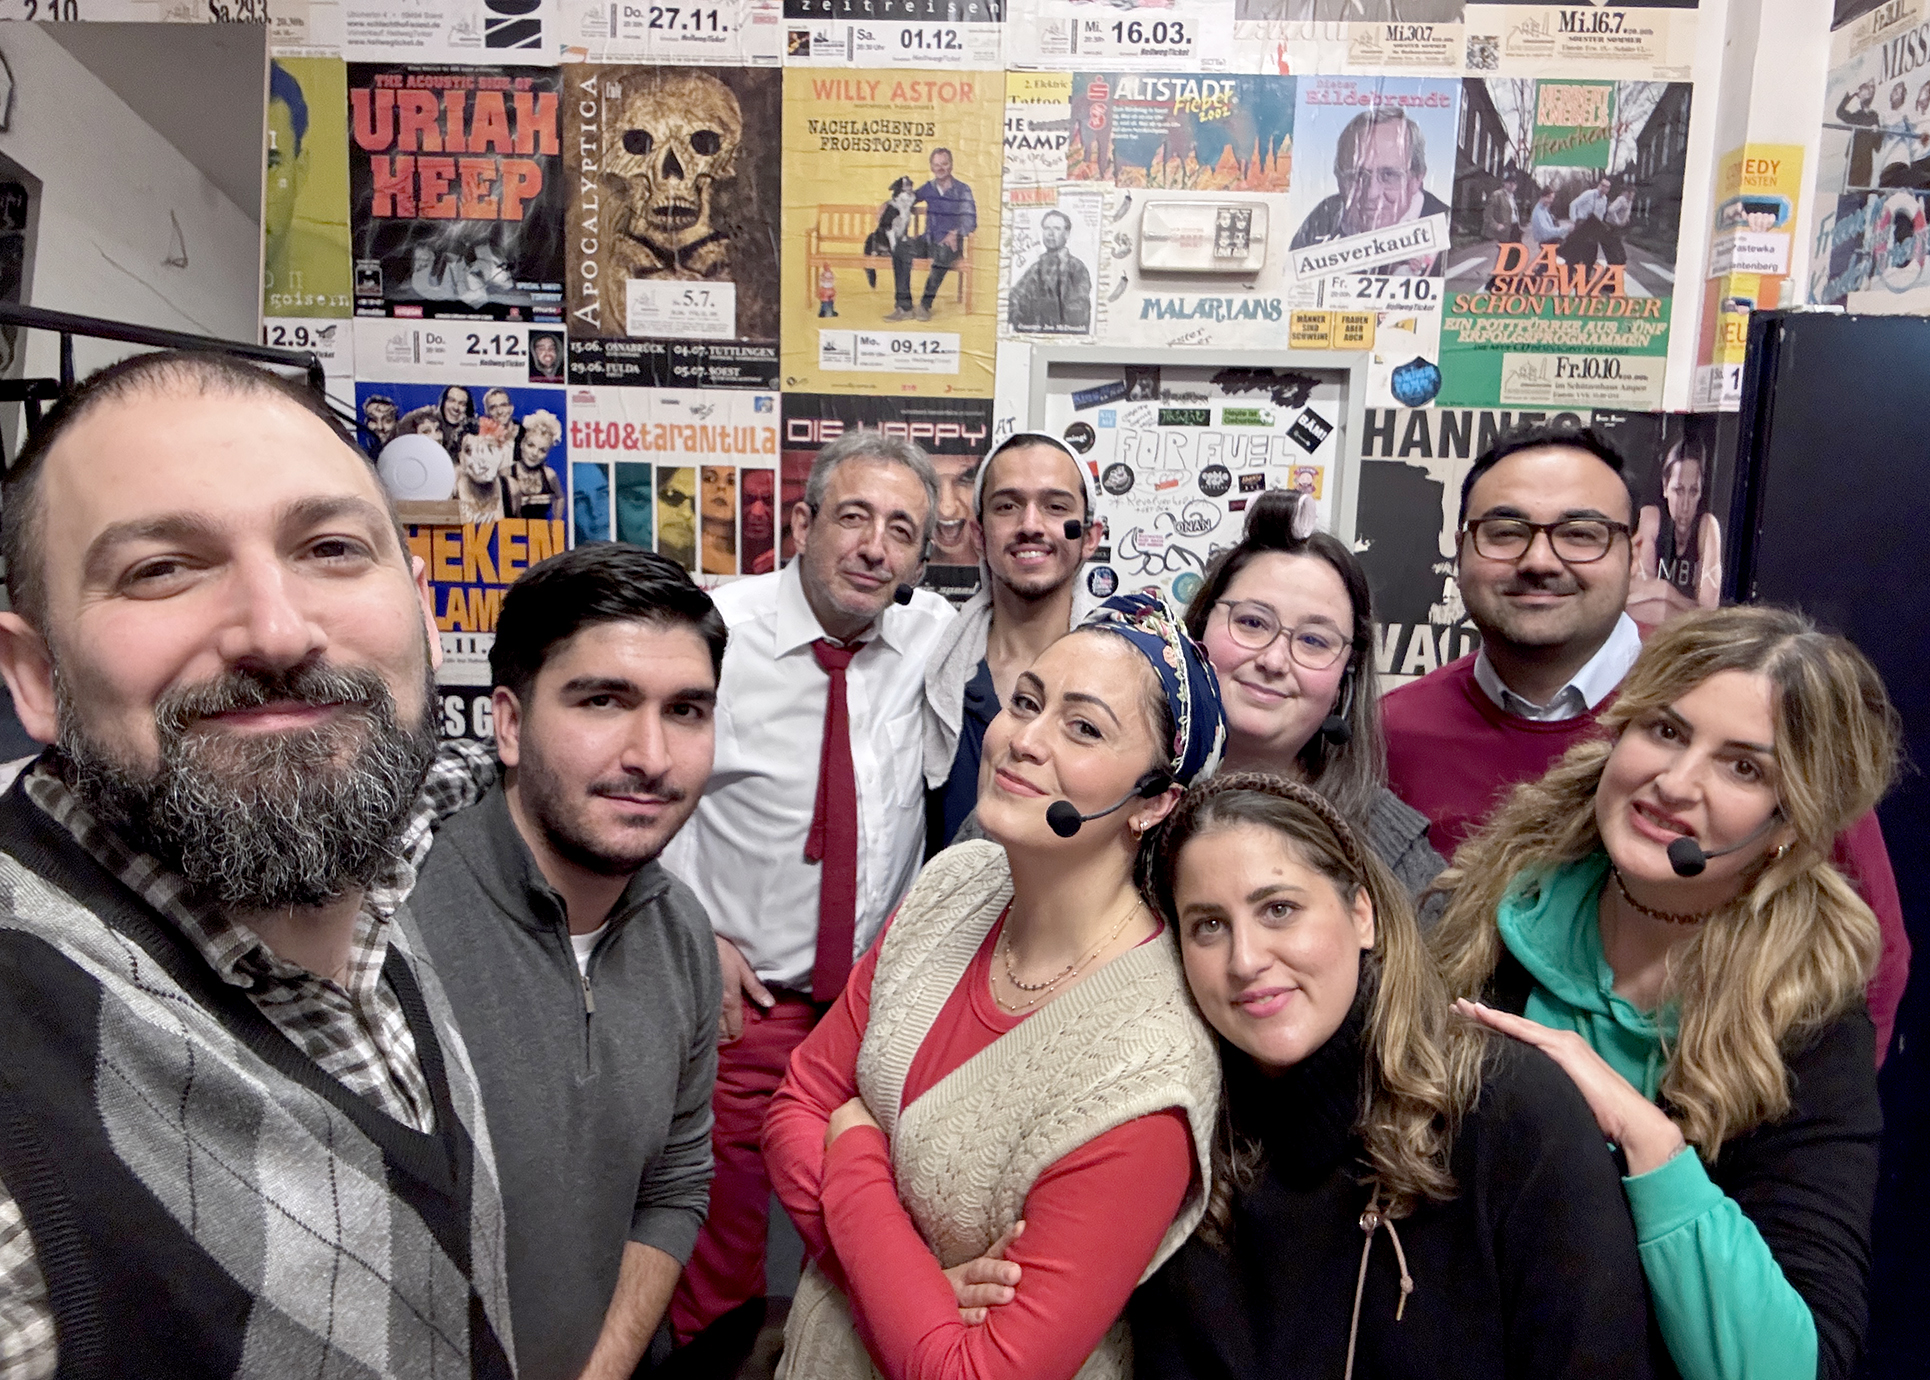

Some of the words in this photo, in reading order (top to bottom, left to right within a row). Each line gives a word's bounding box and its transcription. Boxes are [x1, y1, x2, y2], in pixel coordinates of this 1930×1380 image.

[624, 6, 644, 17] Do.
[648, 7, 727, 31] 27.11.
[857, 29, 875, 41] Sa.
[901, 28, 962, 50] 01.12.
[1085, 21, 1102, 32] Mi.
[1111, 20, 1191, 44] 16.03.
[1879, 22, 1930, 86] MISS
[375, 74, 403, 87] THE
[406, 75, 473, 88] ACOUSTIC
[813, 78, 882, 102] WILLY
[890, 81, 975, 103] ASTOR
[1113, 77, 1236, 104] ALTSTADT
[1305, 90, 1451, 108] Hildebrandt
[350, 88, 560, 155] URIAH
[1199, 106, 1231, 123] 2002
[808, 119, 936, 137] NACHLACHENDE
[820, 137, 923, 153] FROHSTOFFE
[371, 154, 543, 221] HEEP
[573, 75, 602, 330] APOCALYPTICA
[1299, 227, 1431, 275] Ausverkauft
[1491, 242, 1559, 277] DA
[1332, 277, 1348, 288] Fr.
[1356, 277, 1438, 302] 27.10.
[1491, 279, 1557, 295] SIND
[1556, 264, 1626, 298] WA
[683, 289, 716, 307] 5.7.
[1452, 294, 1545, 316] SCHON
[1553, 297, 1662, 319] WIEDER
[1138, 298, 1282, 324] MALARIANS
[1443, 317, 1473, 331] EIN
[1583, 320, 1618, 334] AUS
[427, 333, 446, 345] Do.
[467, 334, 527, 360] 2.12.
[571, 342, 603, 355] 15.06.
[891, 339, 945, 355] 09.12.
[1457, 331, 1651, 347] ERFOLGSPROGRAMMEN
[571, 363, 604, 375] 29.06.
[605, 363, 641, 375] FULDA
[709, 366, 742, 377] SOEST
